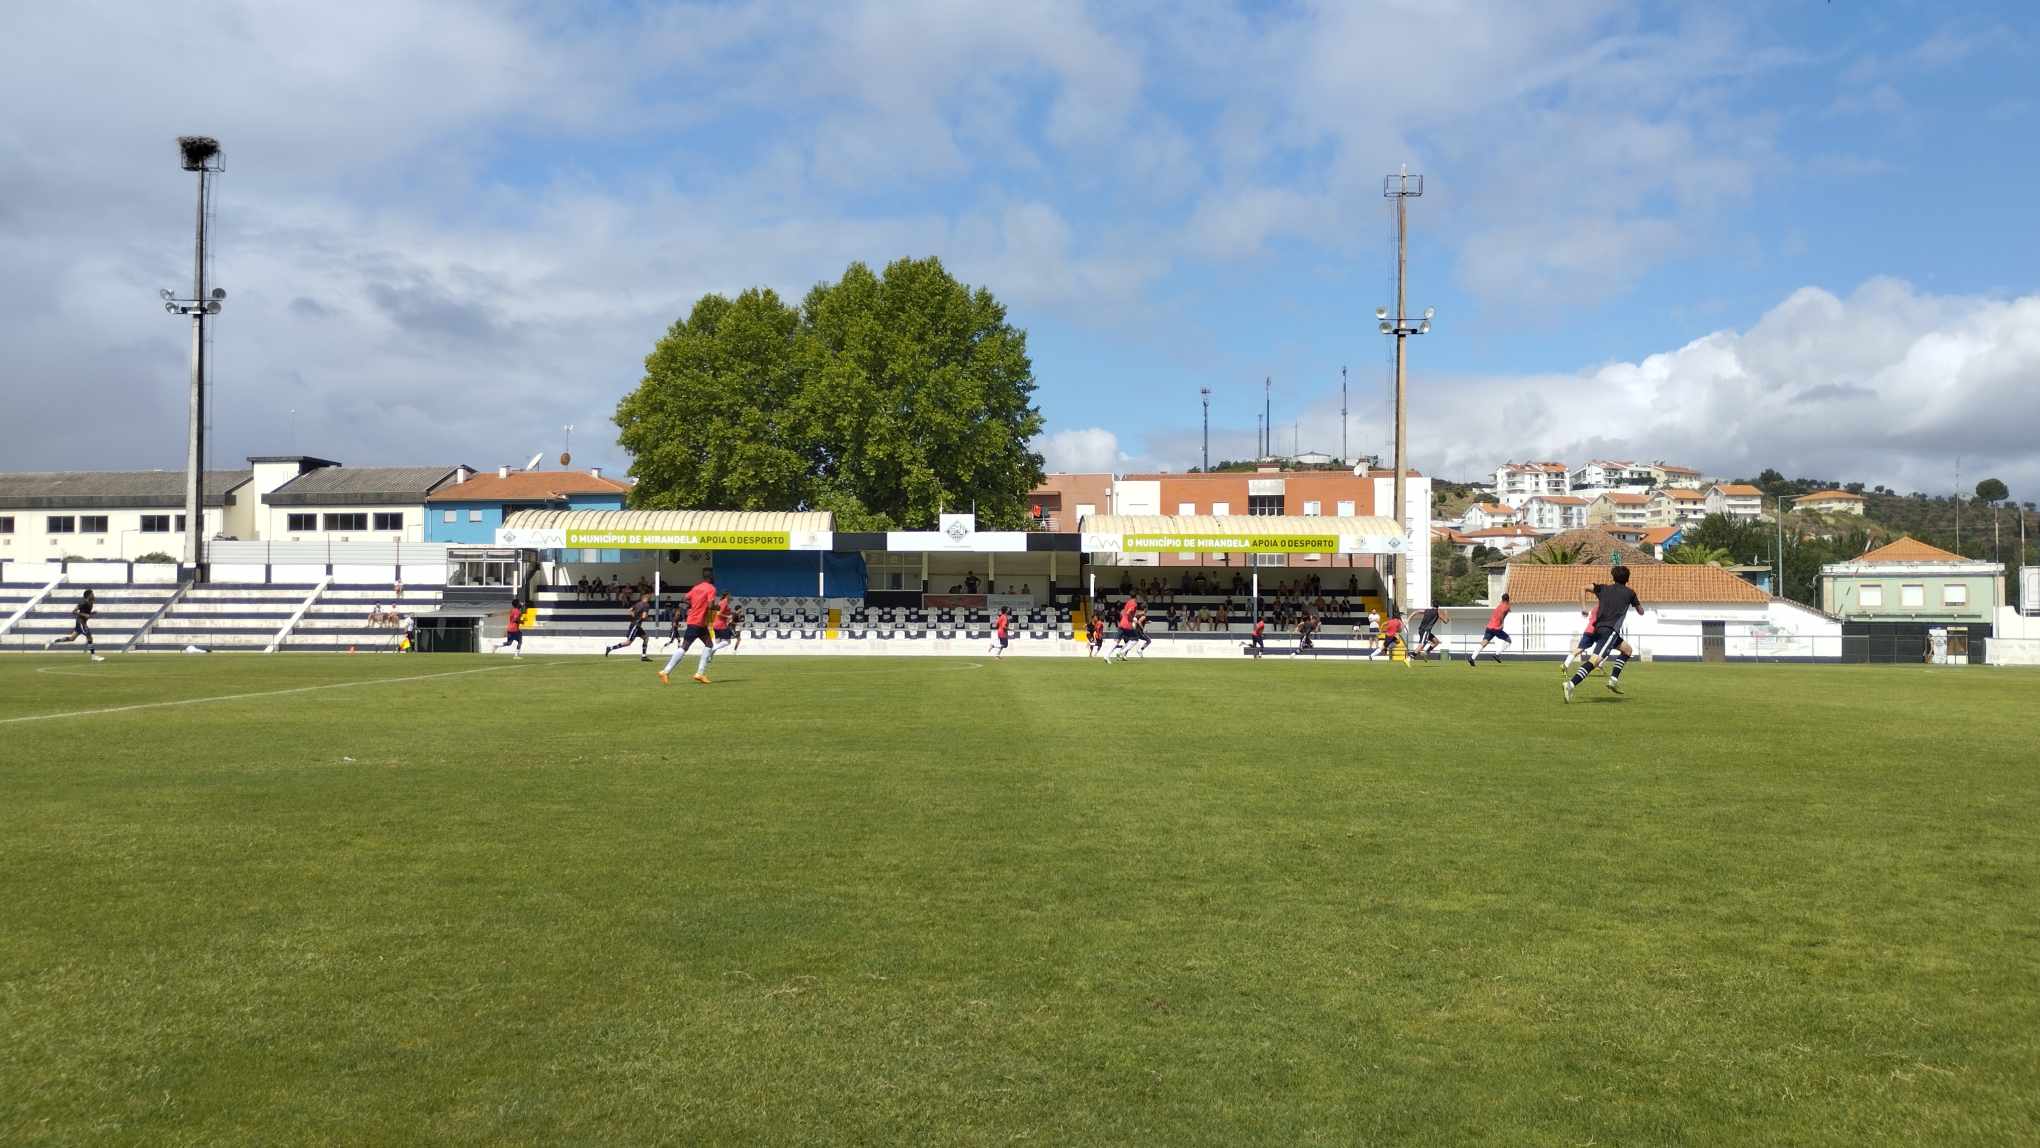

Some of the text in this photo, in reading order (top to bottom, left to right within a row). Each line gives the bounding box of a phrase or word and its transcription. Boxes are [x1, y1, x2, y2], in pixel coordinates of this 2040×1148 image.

[571, 533, 784, 544] O MUNICÍPIO DE MIRANDELA APOIA O DESPORTO
[1136, 537, 1180, 547] MUNICÍPIO
[1184, 539, 1196, 547] DE
[1198, 539, 1250, 547] MIRANDELA
